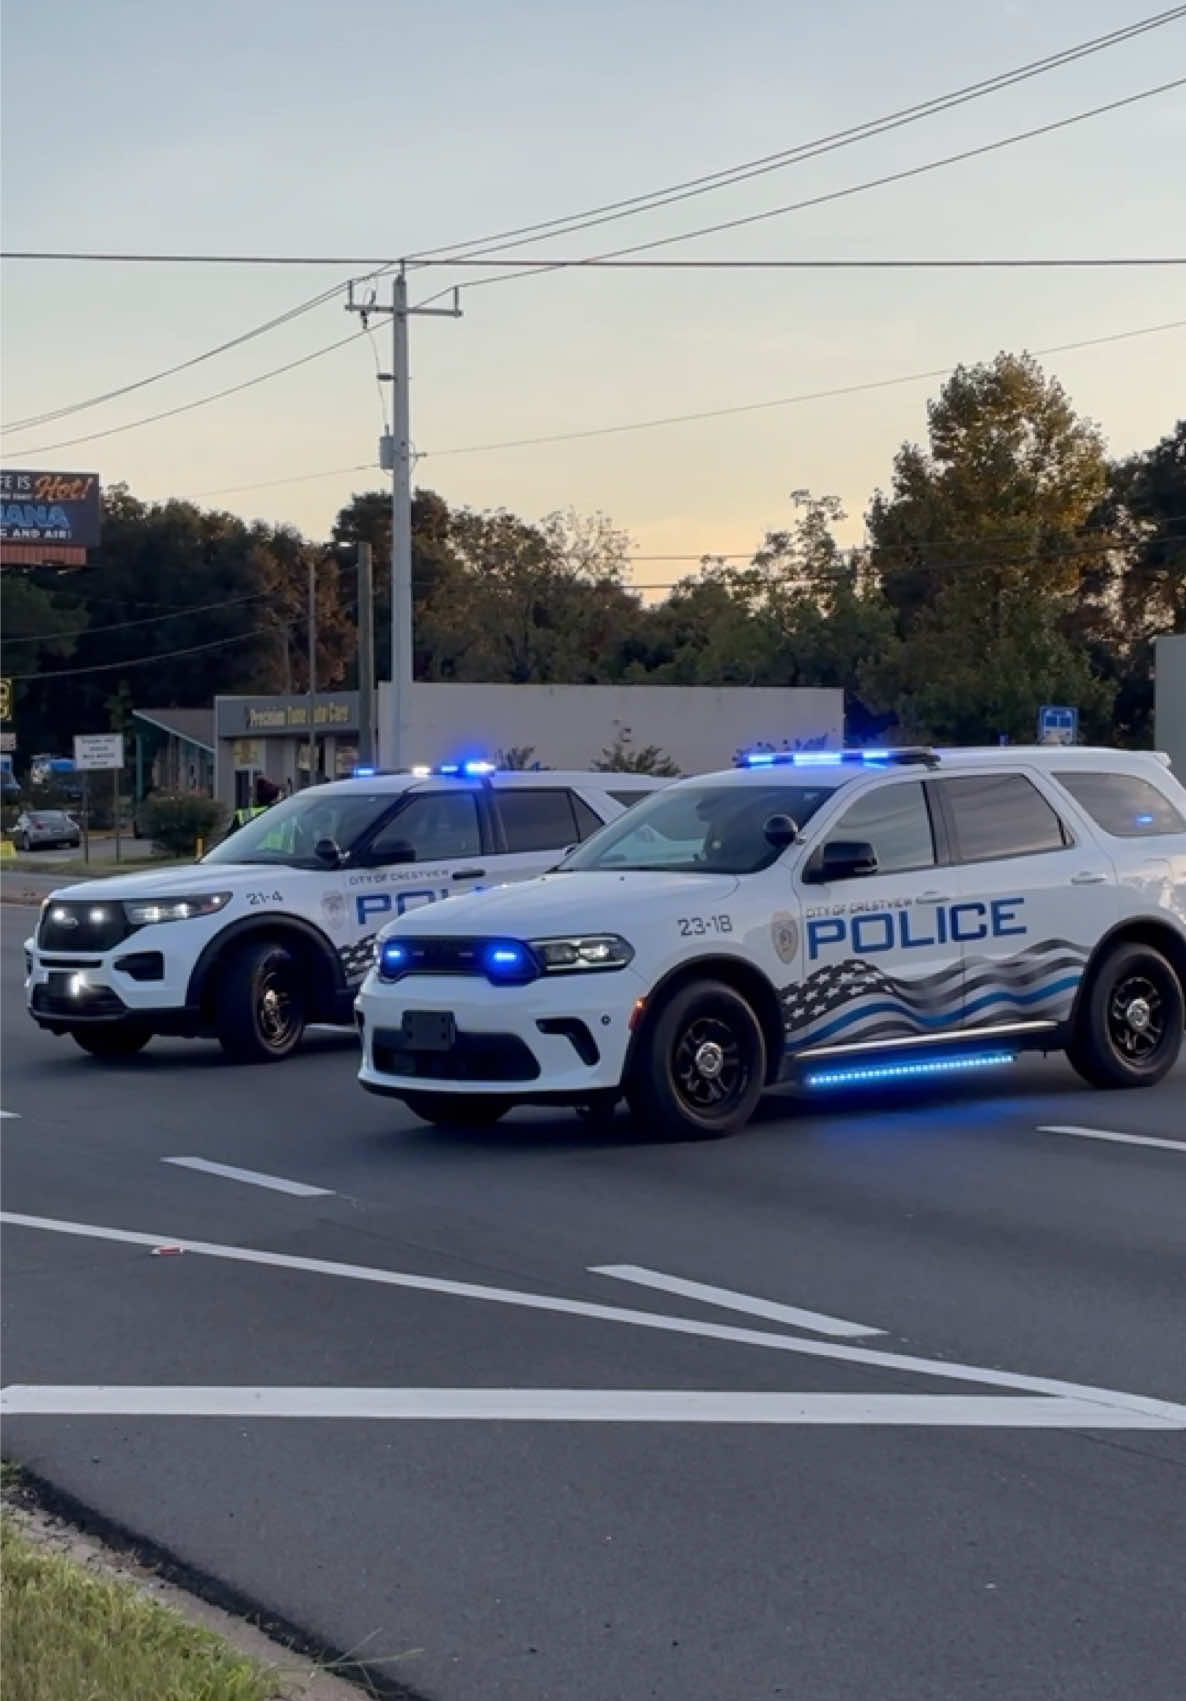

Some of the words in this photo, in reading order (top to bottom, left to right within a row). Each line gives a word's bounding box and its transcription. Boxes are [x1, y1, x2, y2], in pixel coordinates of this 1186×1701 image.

[17, 475, 31, 490] IS
[34, 475, 93, 503] Hot!
[13, 529, 40, 538] AND
[246, 890, 283, 905] 21-4
[677, 914, 732, 936] 23-18
[806, 897, 1027, 960] POLICE
